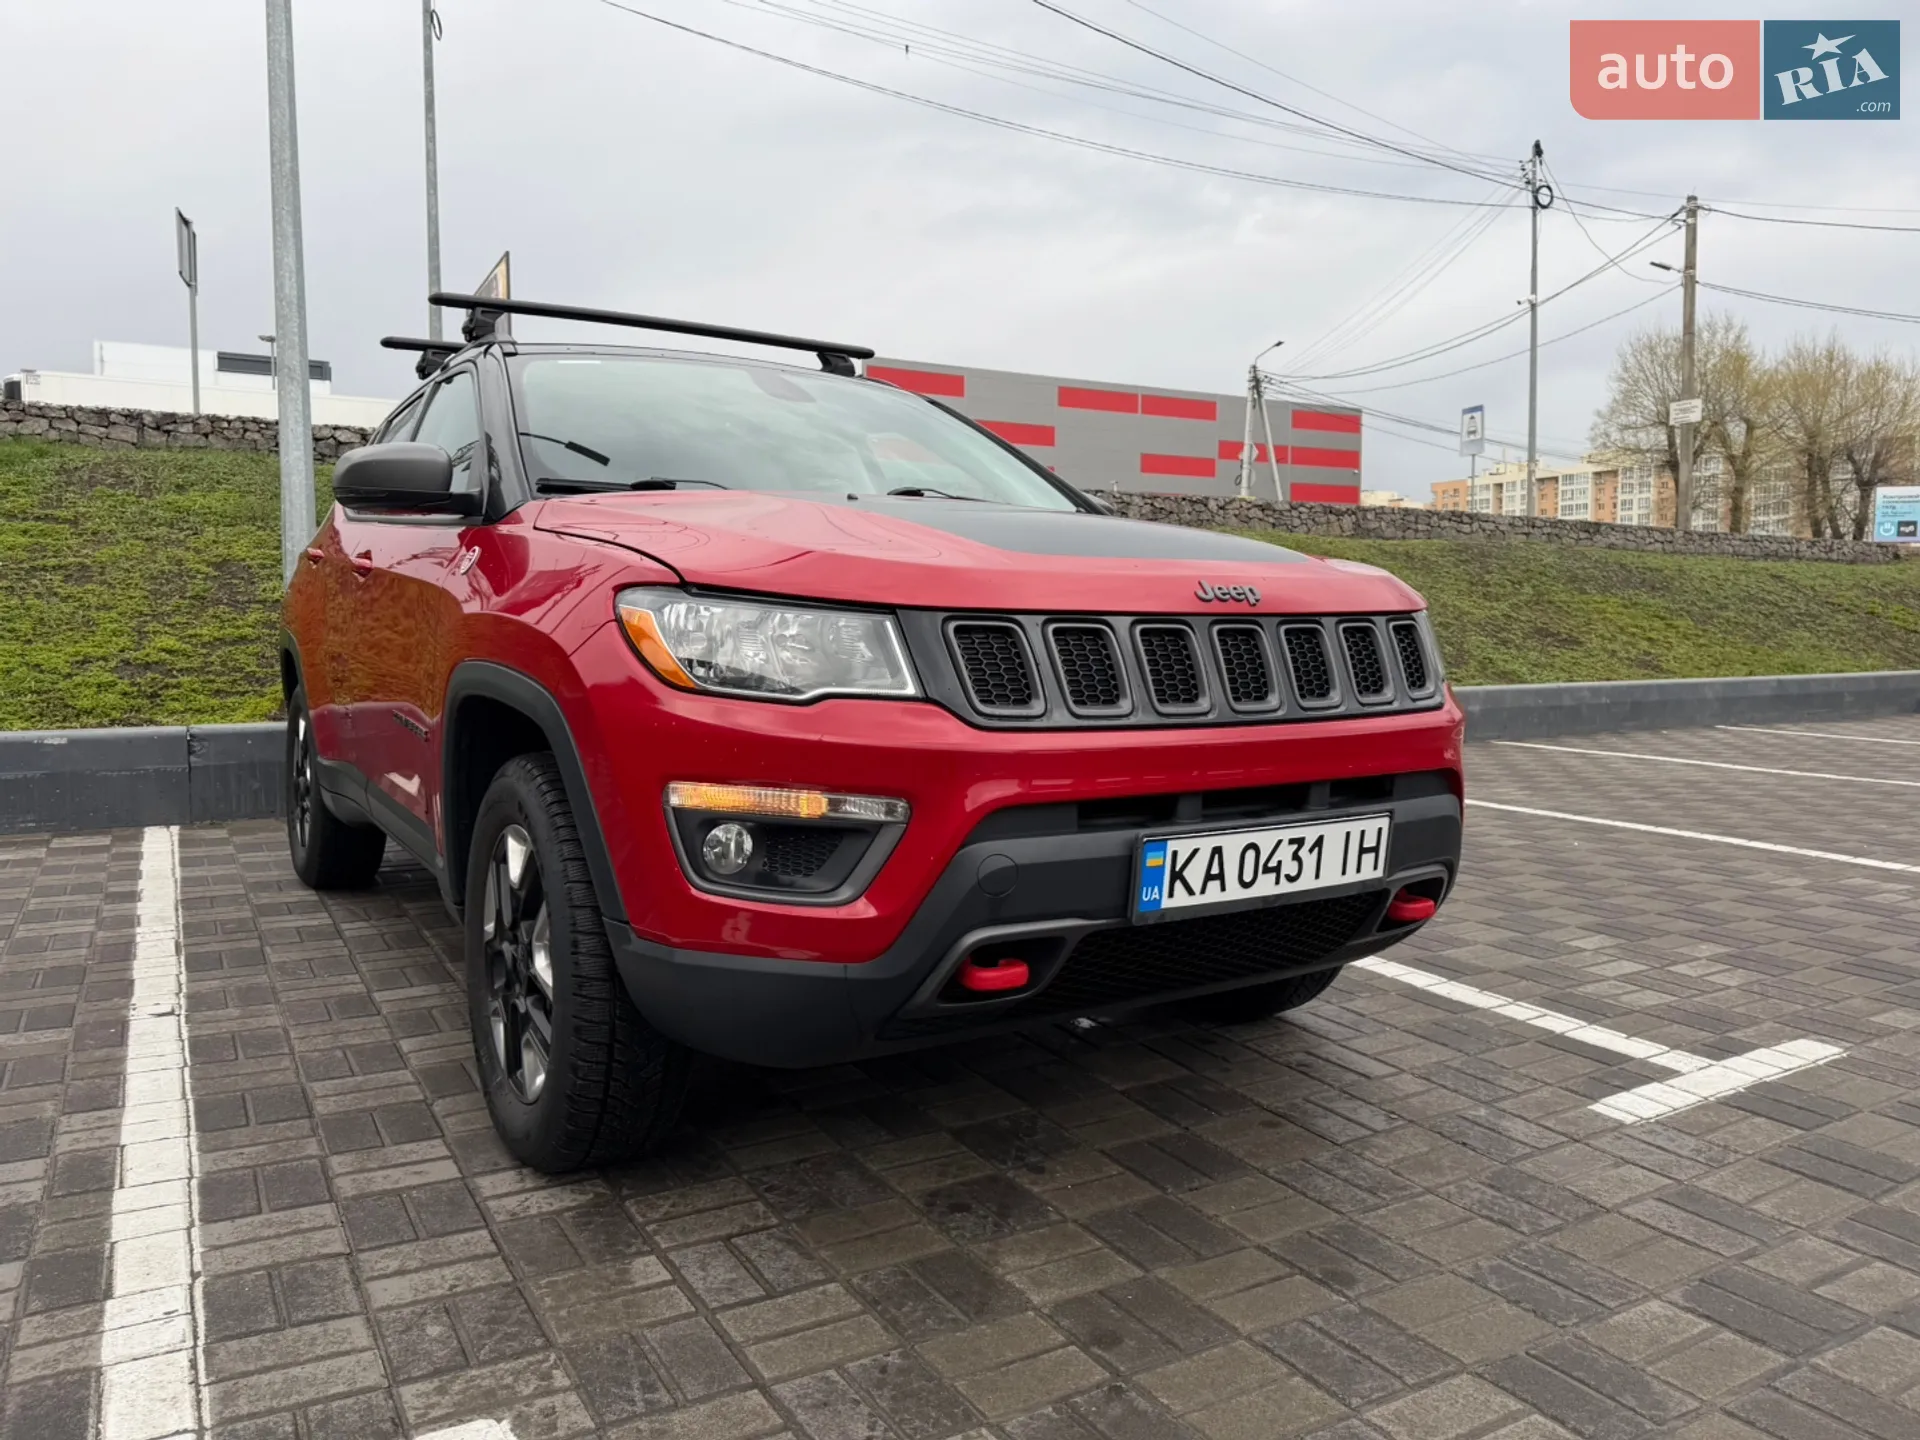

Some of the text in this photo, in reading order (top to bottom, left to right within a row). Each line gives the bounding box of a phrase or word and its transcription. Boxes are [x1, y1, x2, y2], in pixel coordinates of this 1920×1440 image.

[1194, 580, 1262, 607] Jeep
[1167, 826, 1384, 899] KA 0431 IH
[1142, 885, 1160, 901] UA
